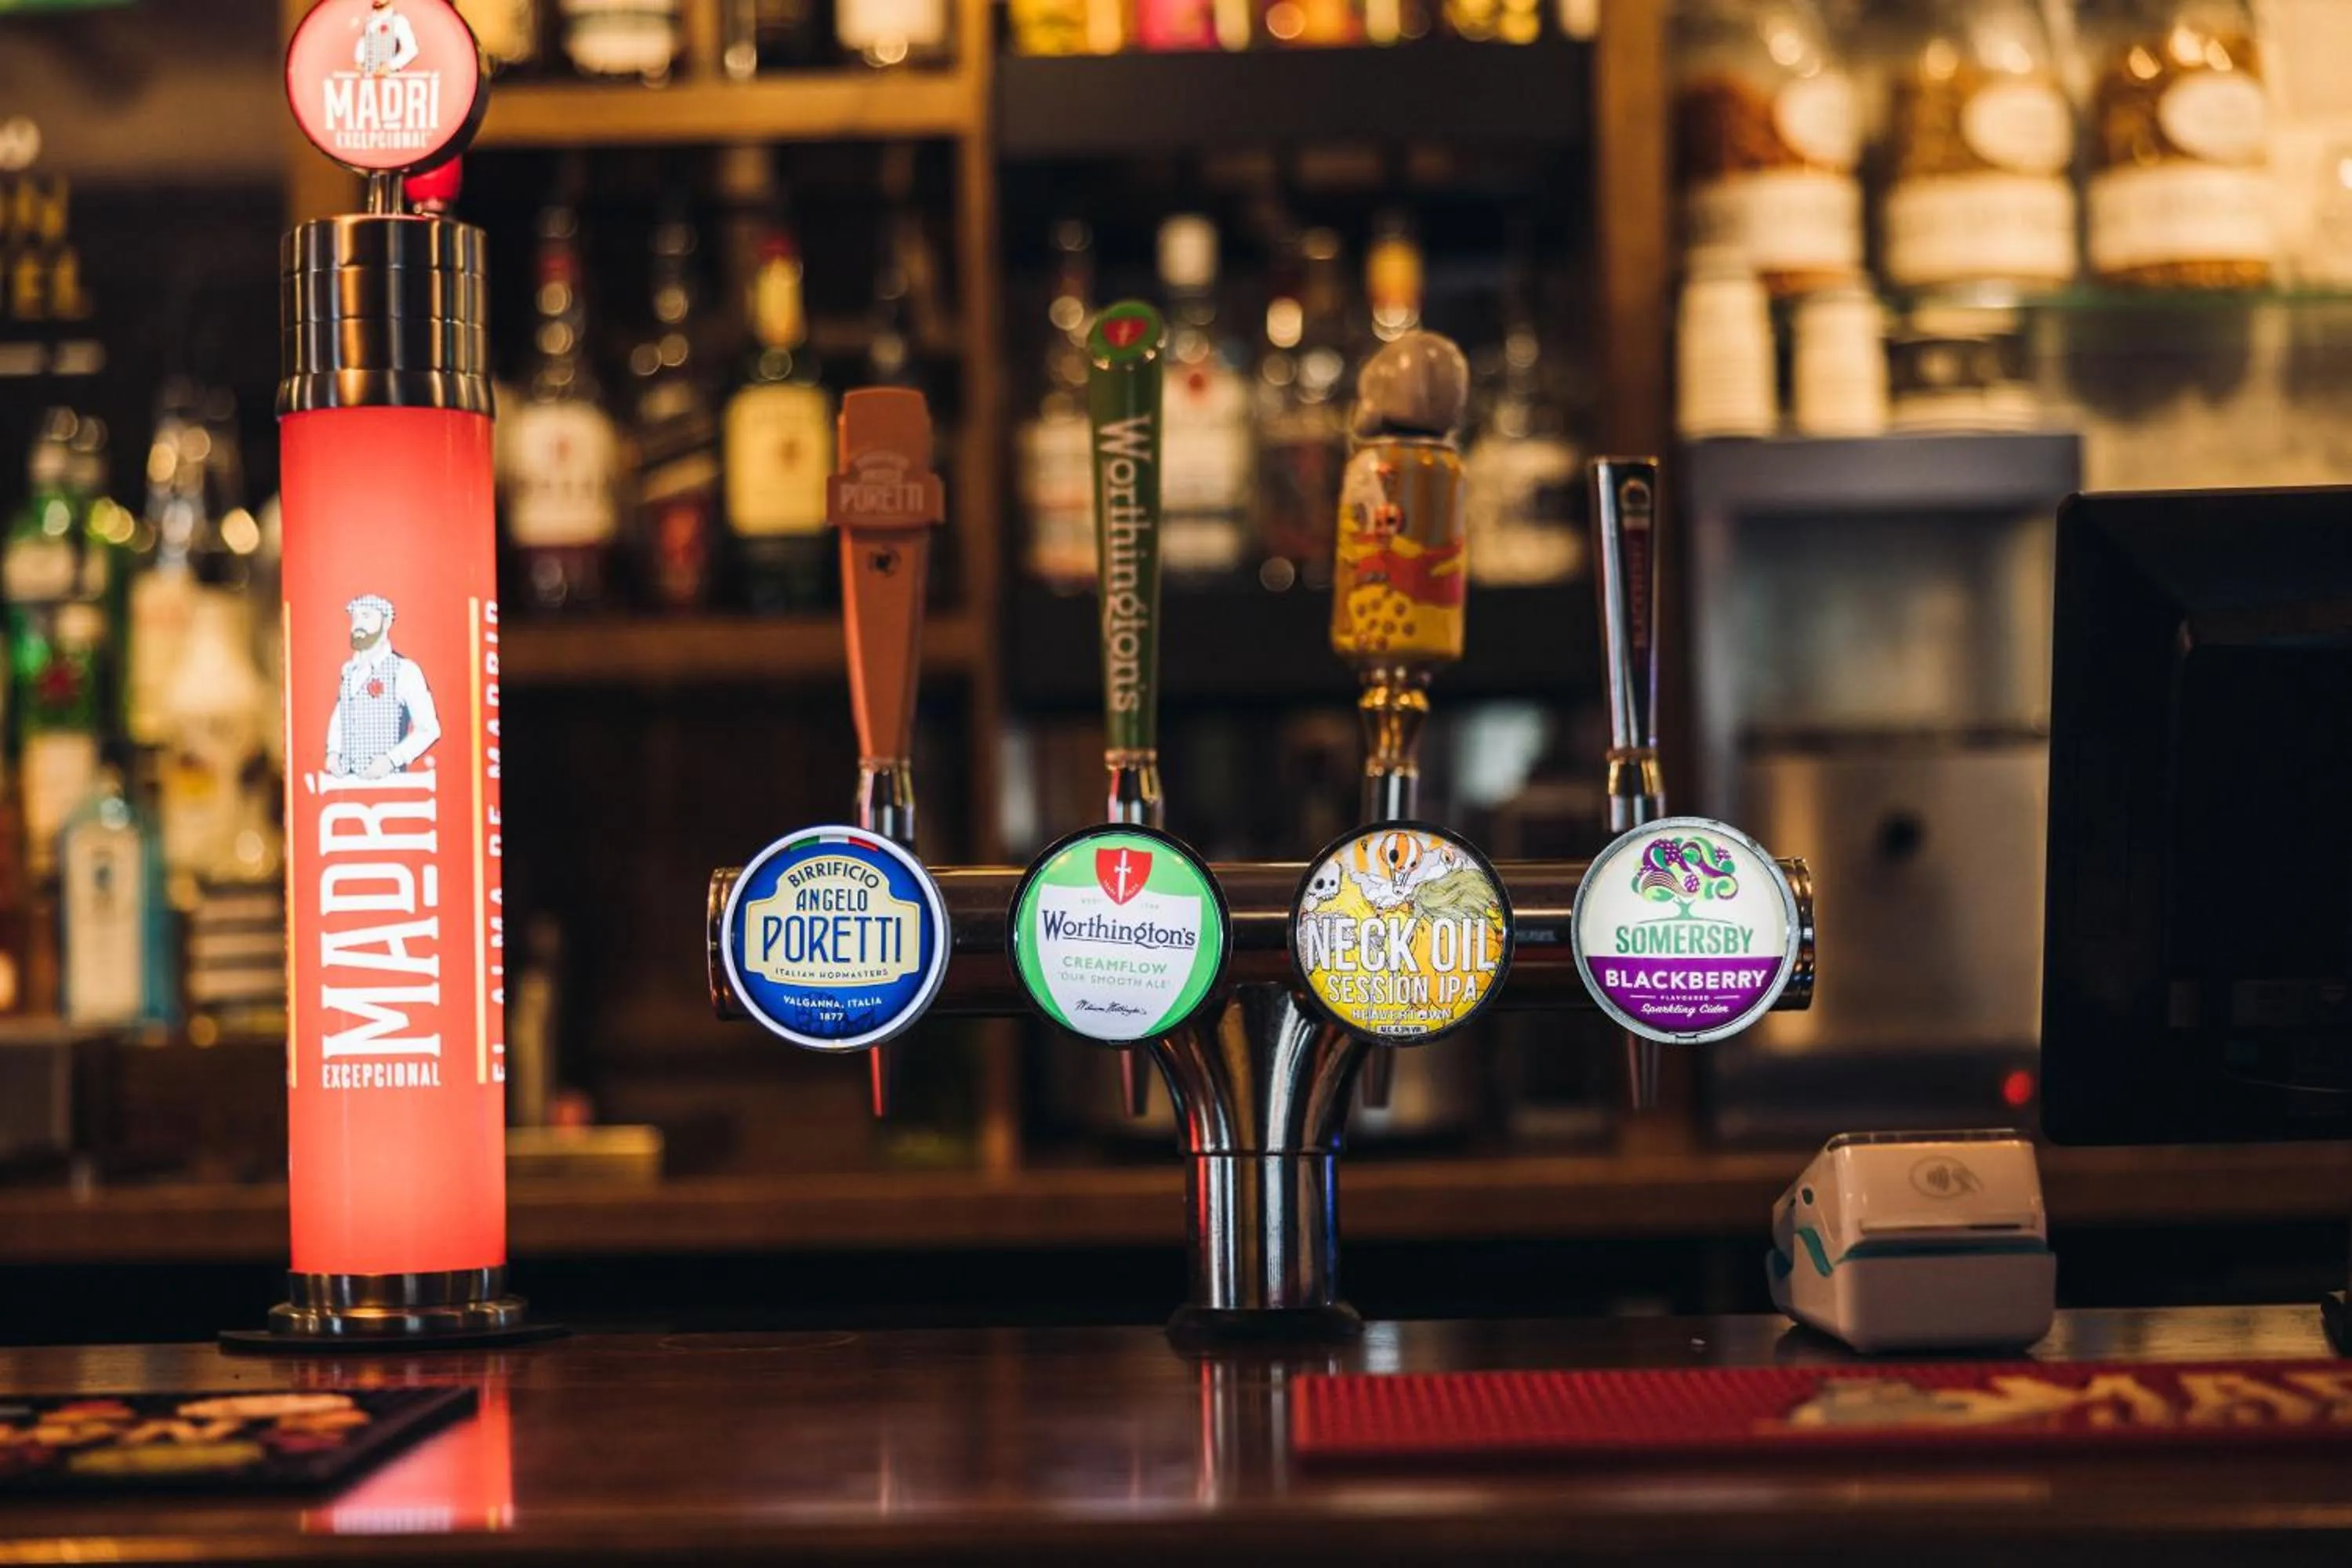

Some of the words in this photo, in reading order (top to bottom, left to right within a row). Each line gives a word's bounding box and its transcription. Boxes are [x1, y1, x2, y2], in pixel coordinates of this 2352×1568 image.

[787, 862, 880, 888] BIRRIFICIO
[796, 888, 869, 912] ANGELO
[761, 915, 902, 964] PORETTI
[1042, 909, 1197, 949] Worthington's
[1615, 923, 1755, 955] SOMERSBY
[1305, 916, 1420, 973] NECK
[1431, 917, 1497, 972] OIL
[775, 967, 815, 978] ITALIAN
[819, 968, 889, 979] HOPMASTERS
[1062, 955, 1168, 975] CREAMFLOW
[1091, 975, 1142, 986] SMOOTH
[1327, 975, 1430, 1004] SESSION
[1439, 975, 1478, 1004] IPA
[1605, 969, 1767, 989] BLACKBERRY
[848, 996, 883, 1008] ITALIA
[1641, 1003, 1697, 1018] Sparkling
[1700, 1004, 1730, 1014] Cider
[819, 1011, 844, 1021] 1877
[321, 1061, 441, 1089] EXCEPCIONAL
